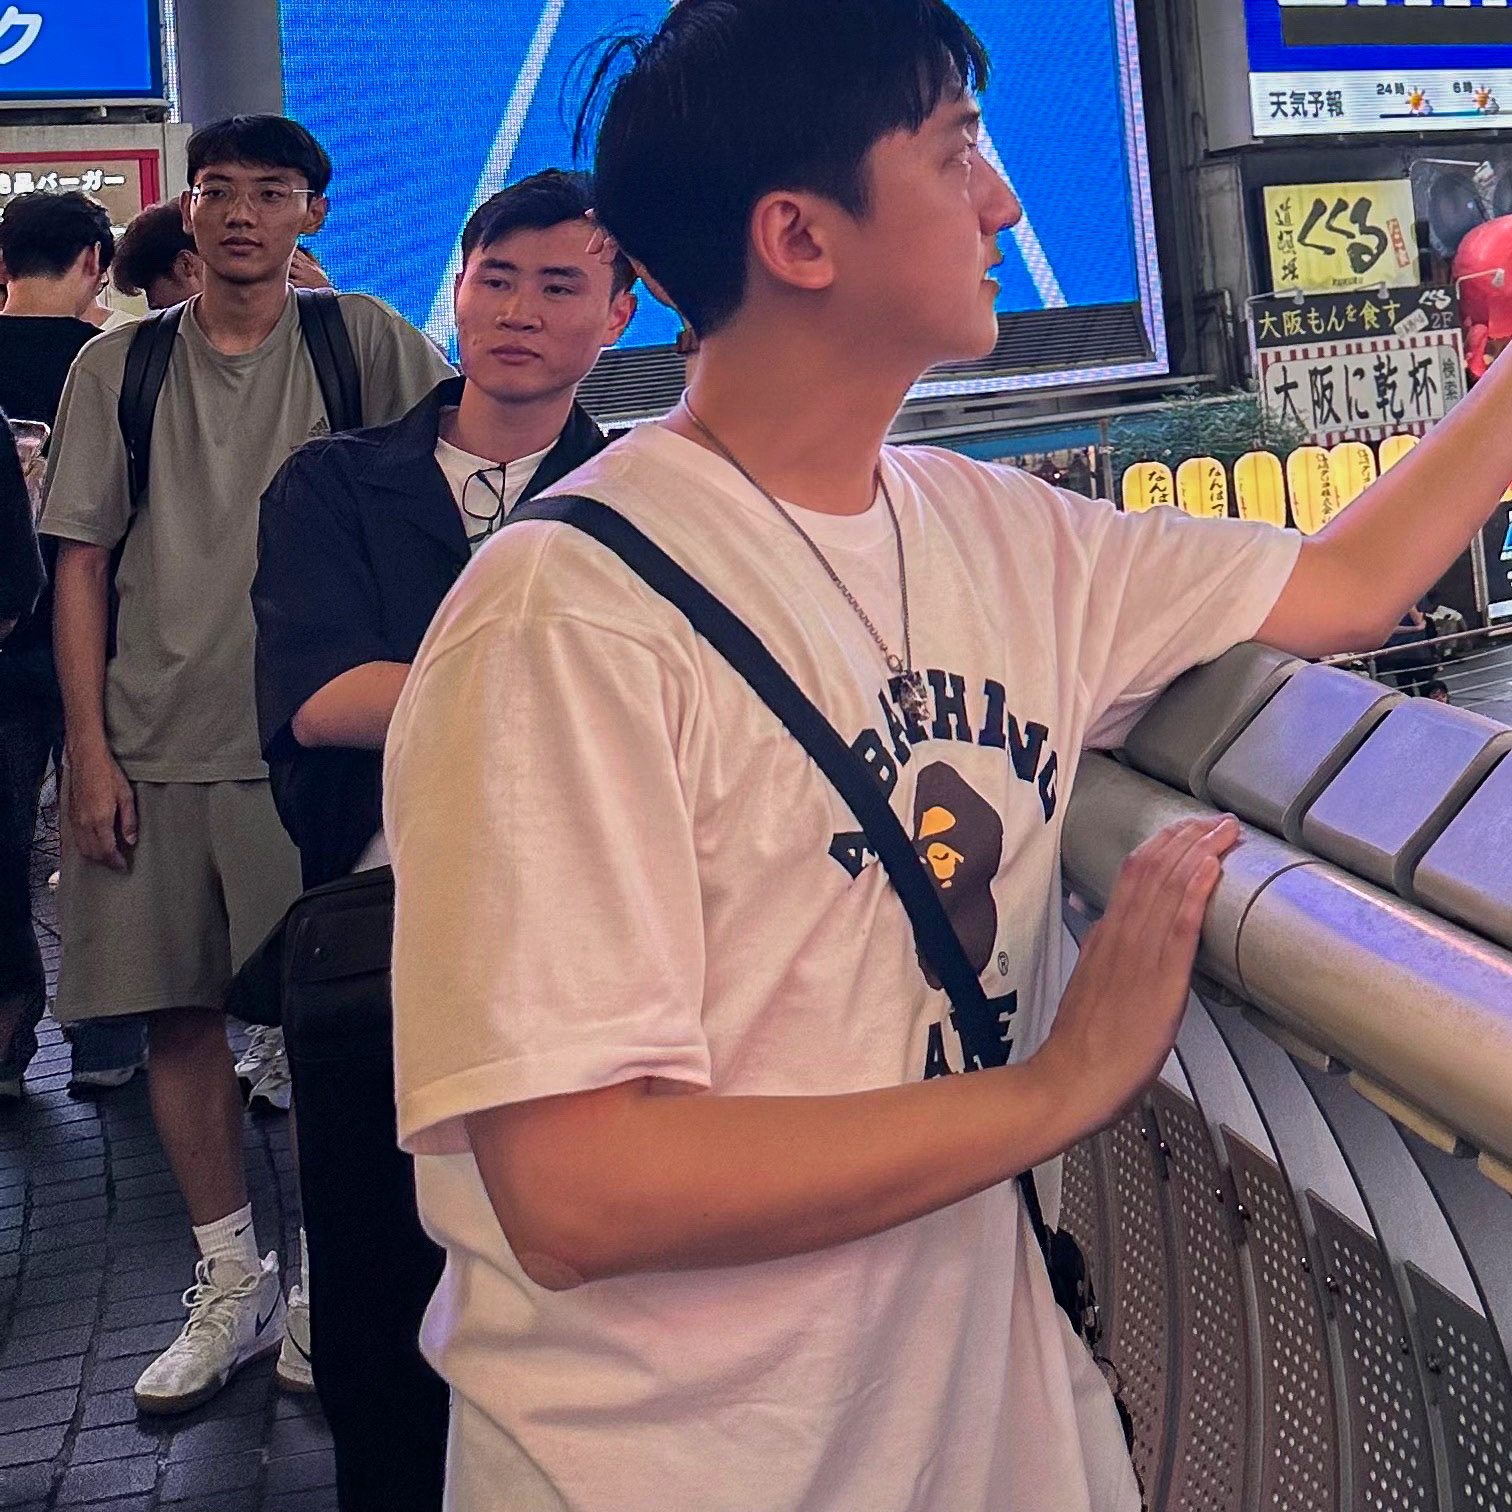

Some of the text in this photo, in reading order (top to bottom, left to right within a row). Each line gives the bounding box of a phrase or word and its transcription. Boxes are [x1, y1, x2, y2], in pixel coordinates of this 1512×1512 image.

[1269, 89, 1345, 119] 天気予報
[1375, 82, 1405, 96] 24時
[1453, 81, 1473, 95] 6時
[1297, 196, 1389, 275] くくる
[1259, 299, 1400, 339] 大阪もんを食す
[1430, 312, 1454, 329] 2F
[1274, 351, 1438, 430] 大阪に乾杯
